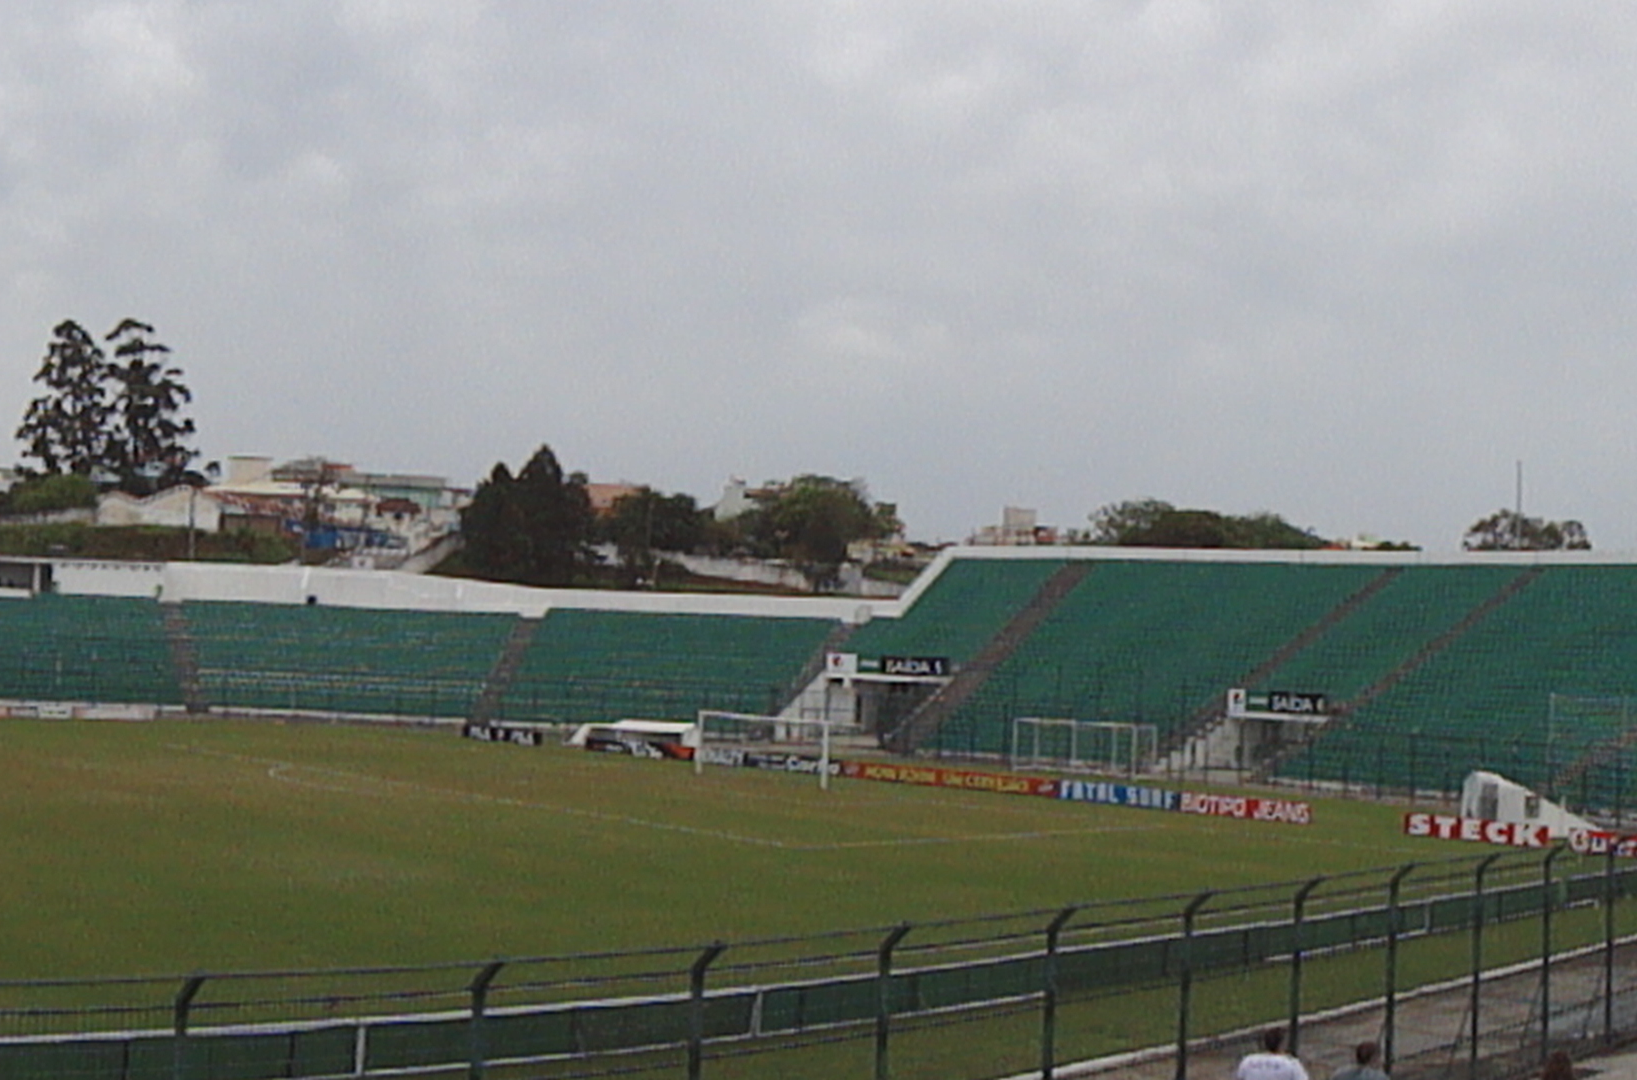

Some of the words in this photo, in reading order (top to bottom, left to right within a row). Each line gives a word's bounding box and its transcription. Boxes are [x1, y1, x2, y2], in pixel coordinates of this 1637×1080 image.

[1061, 781, 1118, 804] FATAL
[1126, 786, 1175, 809] SURF
[1181, 792, 1246, 817] BIOTIPO
[1254, 800, 1309, 825] JEANS
[1409, 814, 1543, 847] STECK
